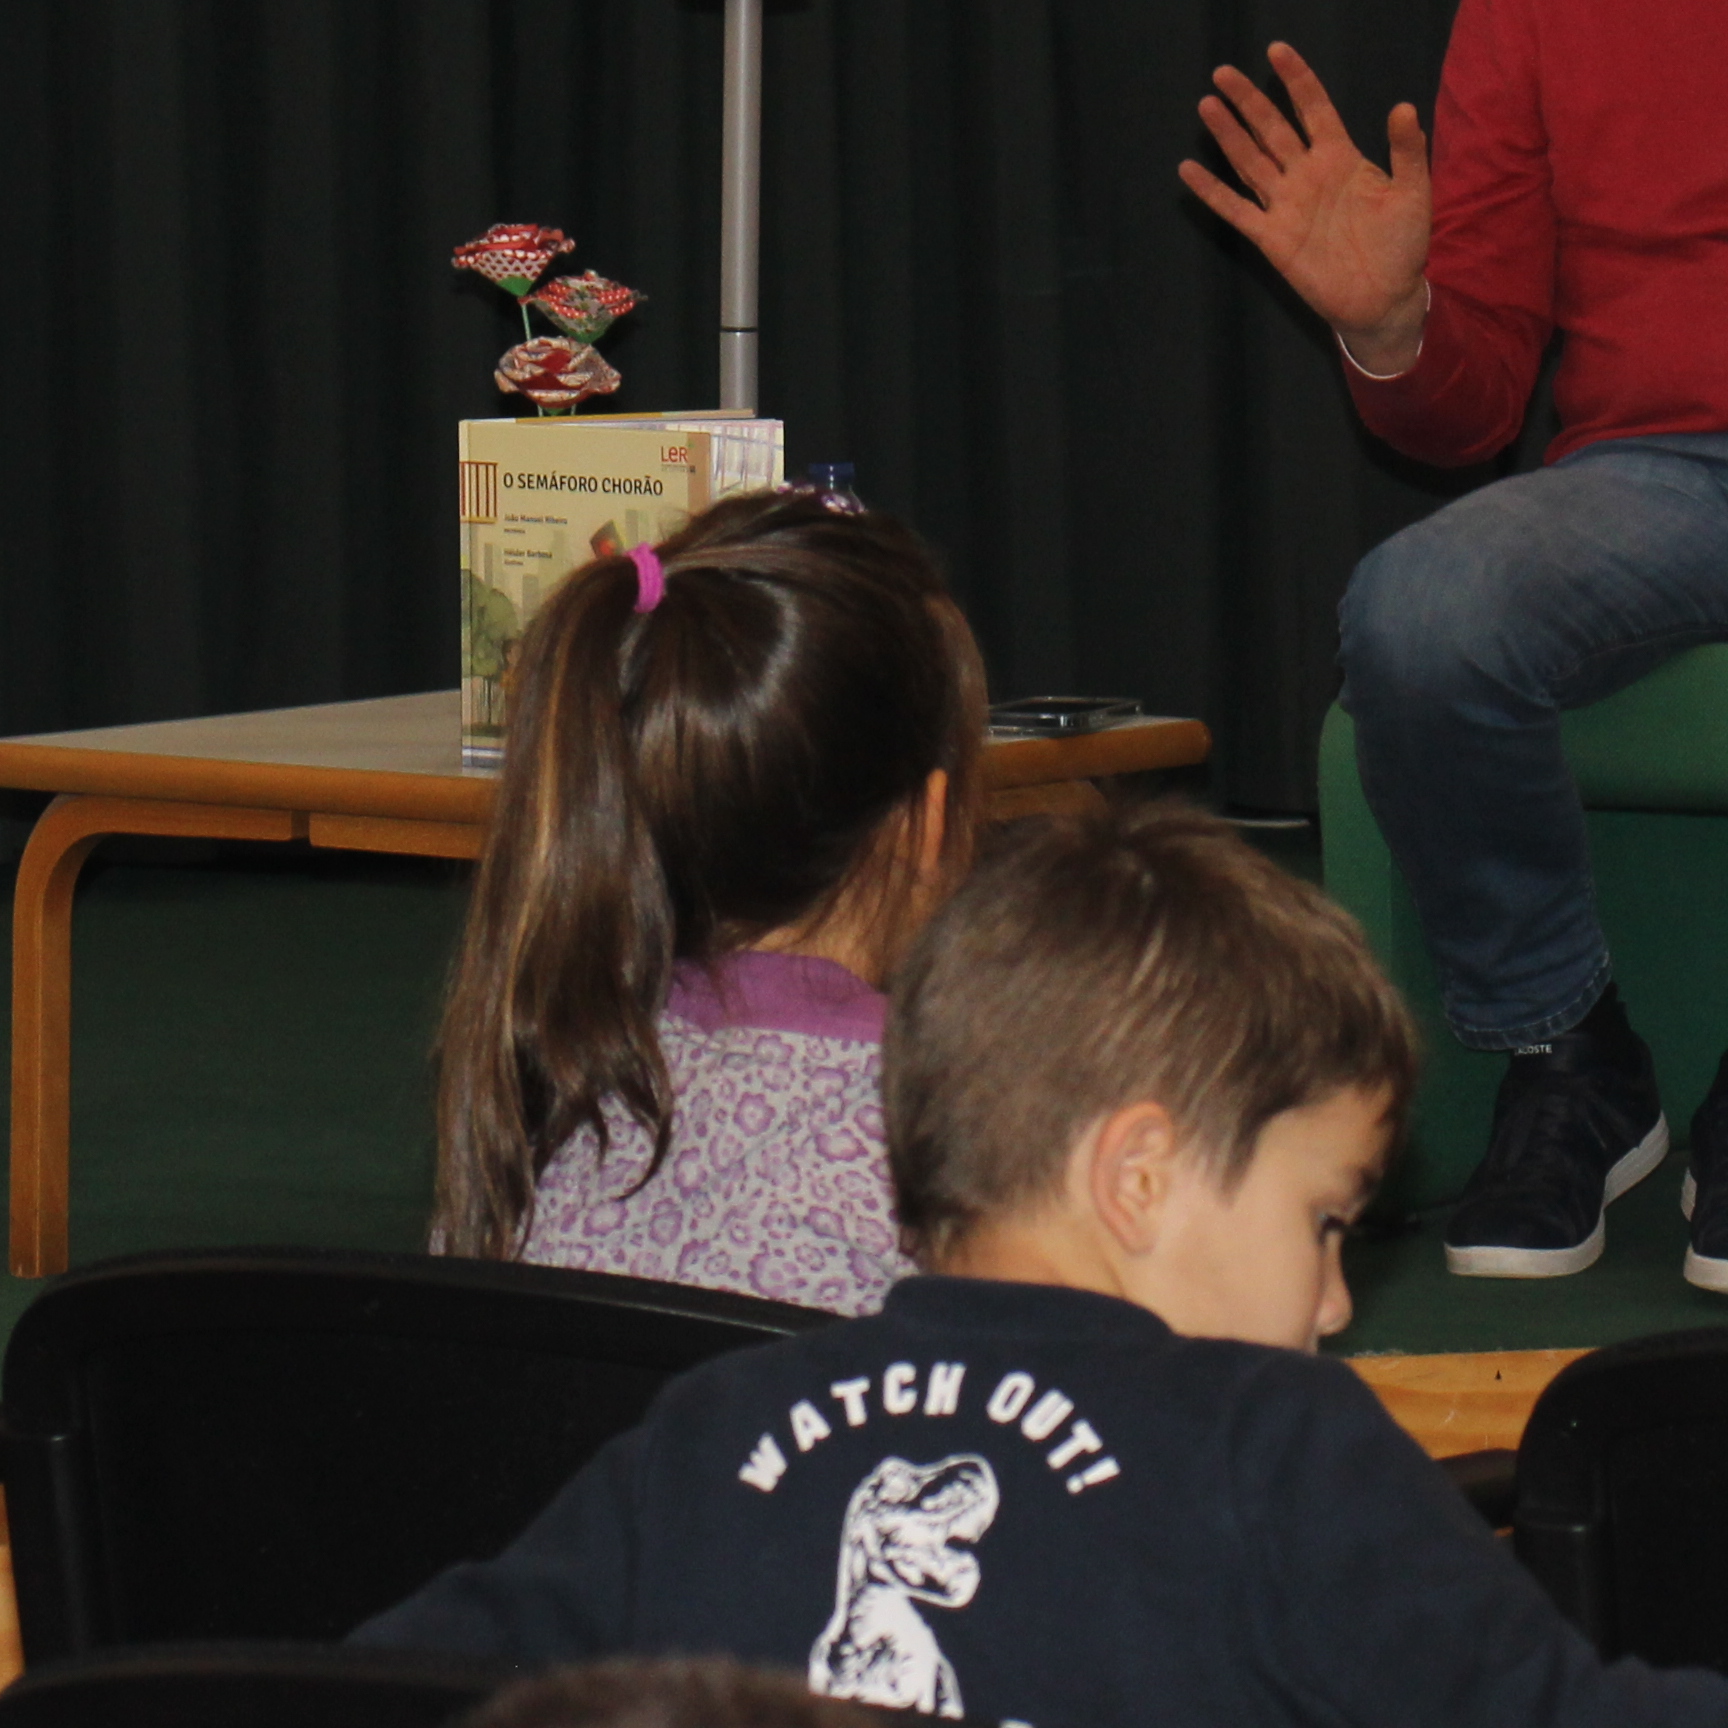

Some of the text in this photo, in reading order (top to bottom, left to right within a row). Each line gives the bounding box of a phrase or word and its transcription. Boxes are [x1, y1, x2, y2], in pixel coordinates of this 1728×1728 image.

[503, 470, 663, 495] O SEMÁFORO CHORÃO
[738, 1362, 1120, 1494] WATCH OUT!
